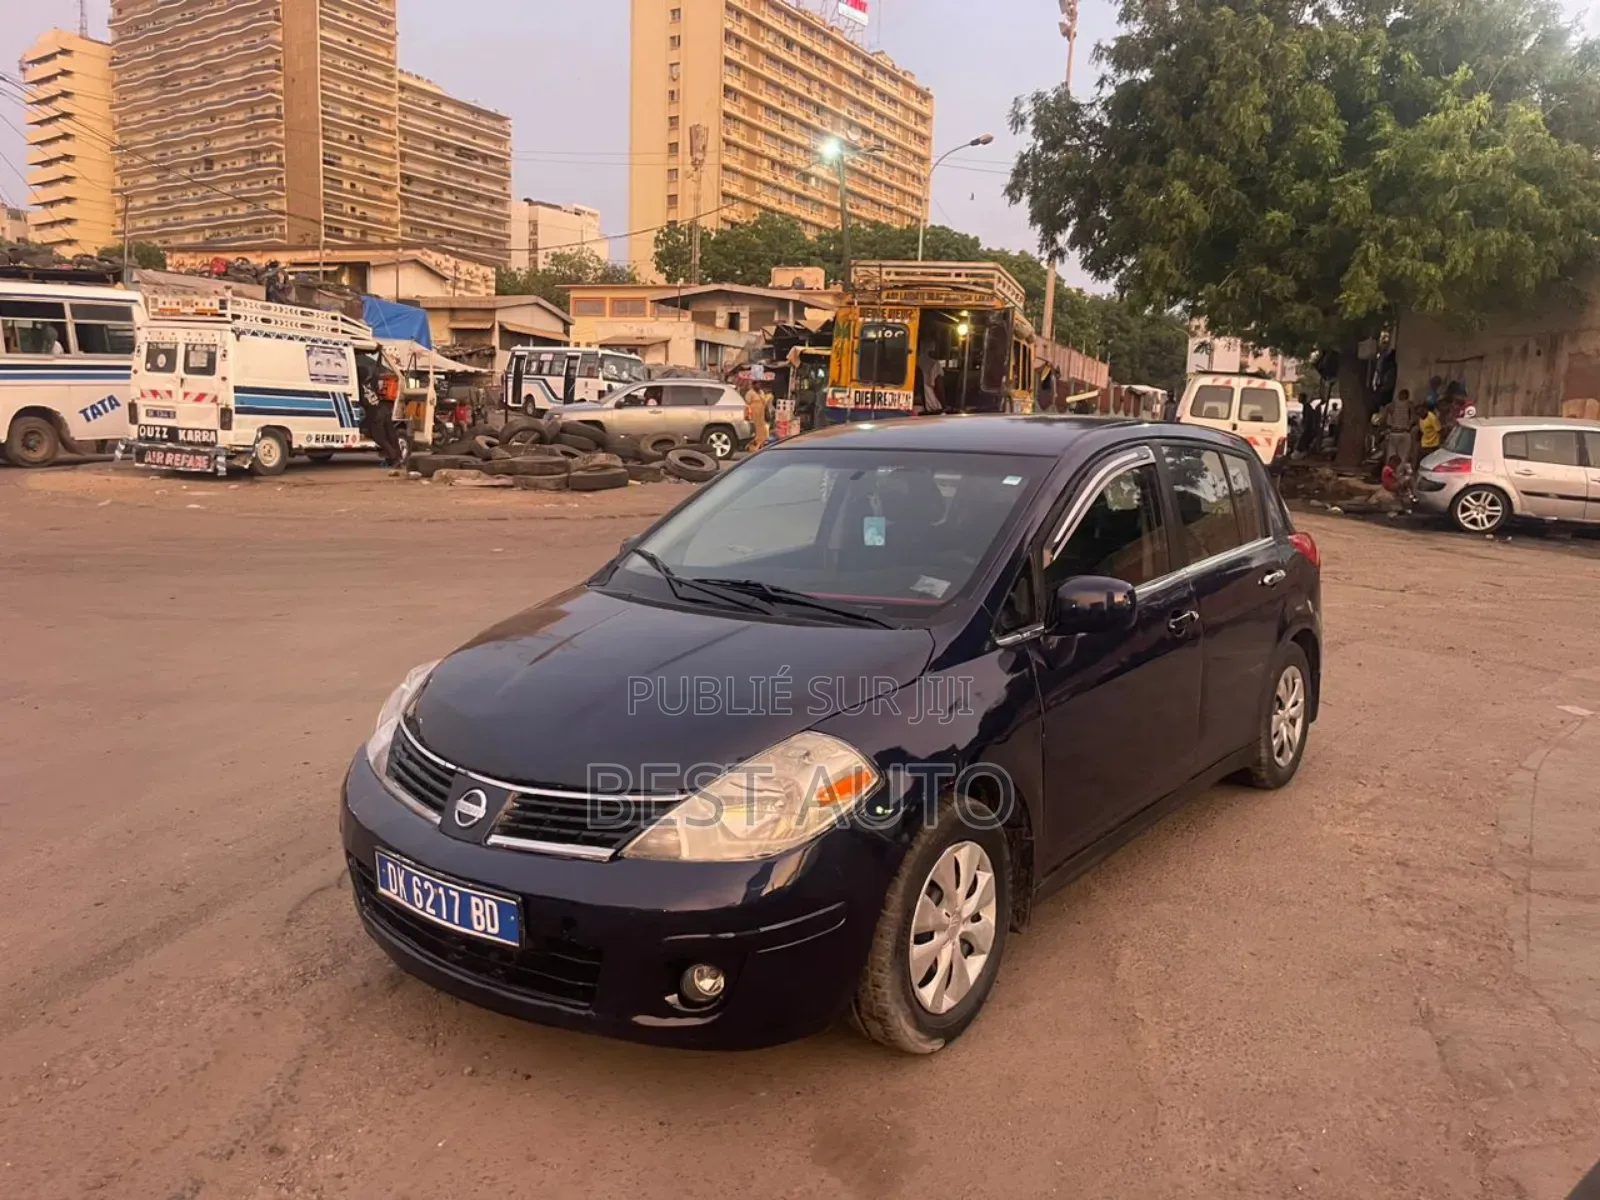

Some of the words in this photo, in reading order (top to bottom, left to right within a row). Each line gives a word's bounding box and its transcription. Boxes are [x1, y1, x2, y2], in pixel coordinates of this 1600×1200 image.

[78, 394, 121, 423] TATA
[178, 429, 216, 442] KARRA
[315, 434, 350, 443] RENAULT
[386, 862, 408, 901] DK
[412, 876, 460, 924] 6217
[470, 896, 500, 934] BD
